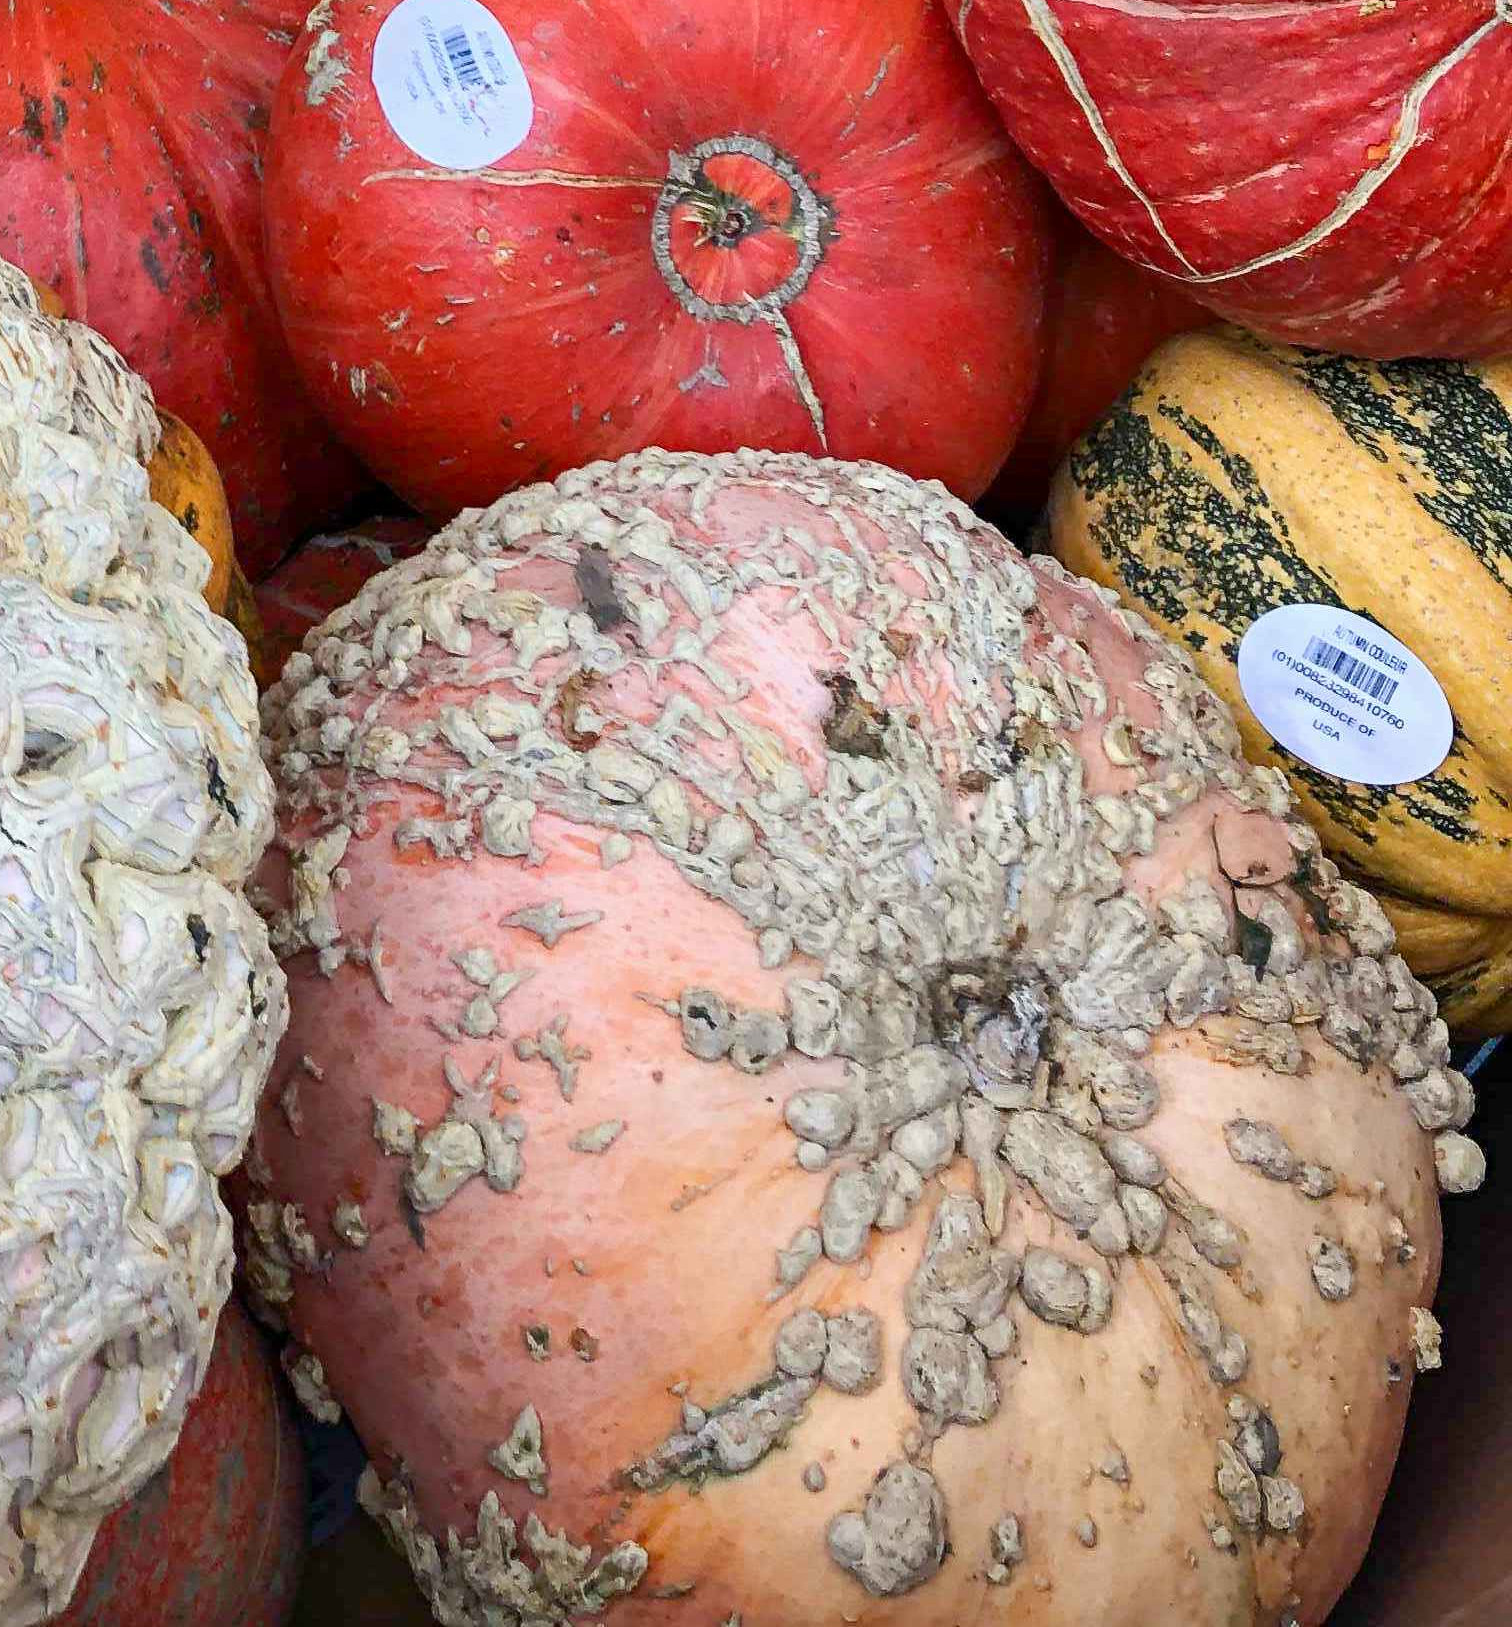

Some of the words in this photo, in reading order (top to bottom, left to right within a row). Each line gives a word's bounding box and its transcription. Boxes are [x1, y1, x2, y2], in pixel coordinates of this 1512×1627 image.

[1272, 648, 1406, 730] (01)00823298410760
[1294, 687, 1358, 726] PRODUCE
[1358, 723, 1378, 738] OF
[1312, 719, 1341, 741] USA
